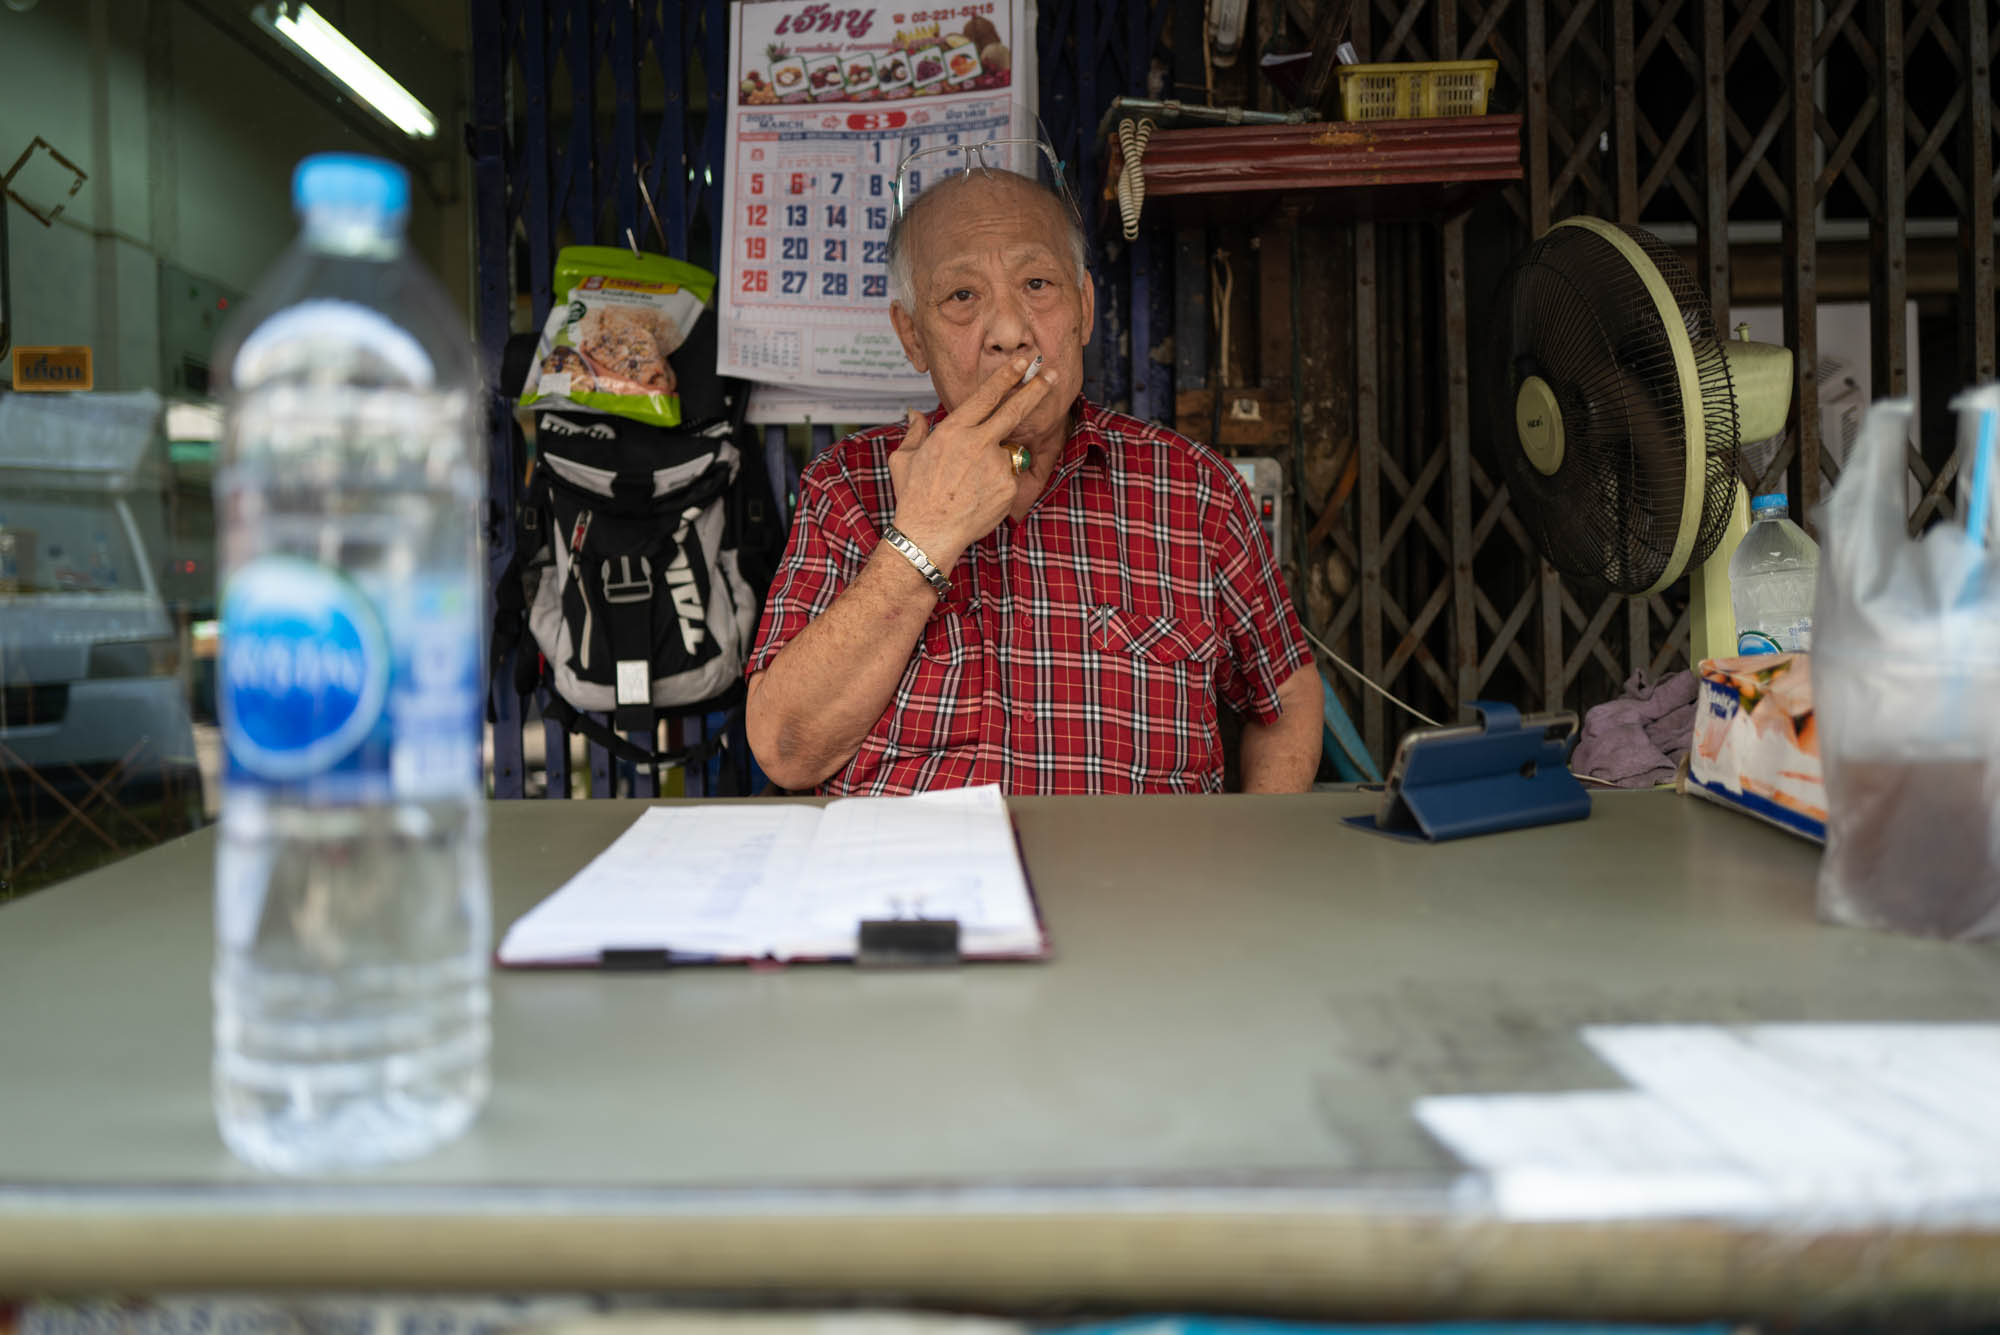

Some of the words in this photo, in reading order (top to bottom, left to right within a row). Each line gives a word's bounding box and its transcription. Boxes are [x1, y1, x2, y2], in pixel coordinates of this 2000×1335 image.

[759, 120, 805, 130] MARCH
[872, 140, 881, 163] 1
[909, 136, 921, 157] 2
[946, 133, 959, 157] 3
[751, 173, 764, 195] 5
[790, 173, 804, 195] 6
[830, 173, 844, 194] 7
[869, 174, 883, 196] 8
[910, 170, 921, 193] 9
[746, 204, 768, 226] 12
[785, 204, 807, 226] 13
[825, 205, 847, 228] 14
[865, 207, 887, 229] 15
[745, 237, 767, 259] 19
[782, 237, 808, 259] 20
[824, 239, 847, 261] 21
[863, 241, 888, 263] 22
[741, 270, 768, 292] 26
[782, 271, 807, 293] 27
[822, 273, 848, 295] 28
[863, 275, 888, 297] 29
